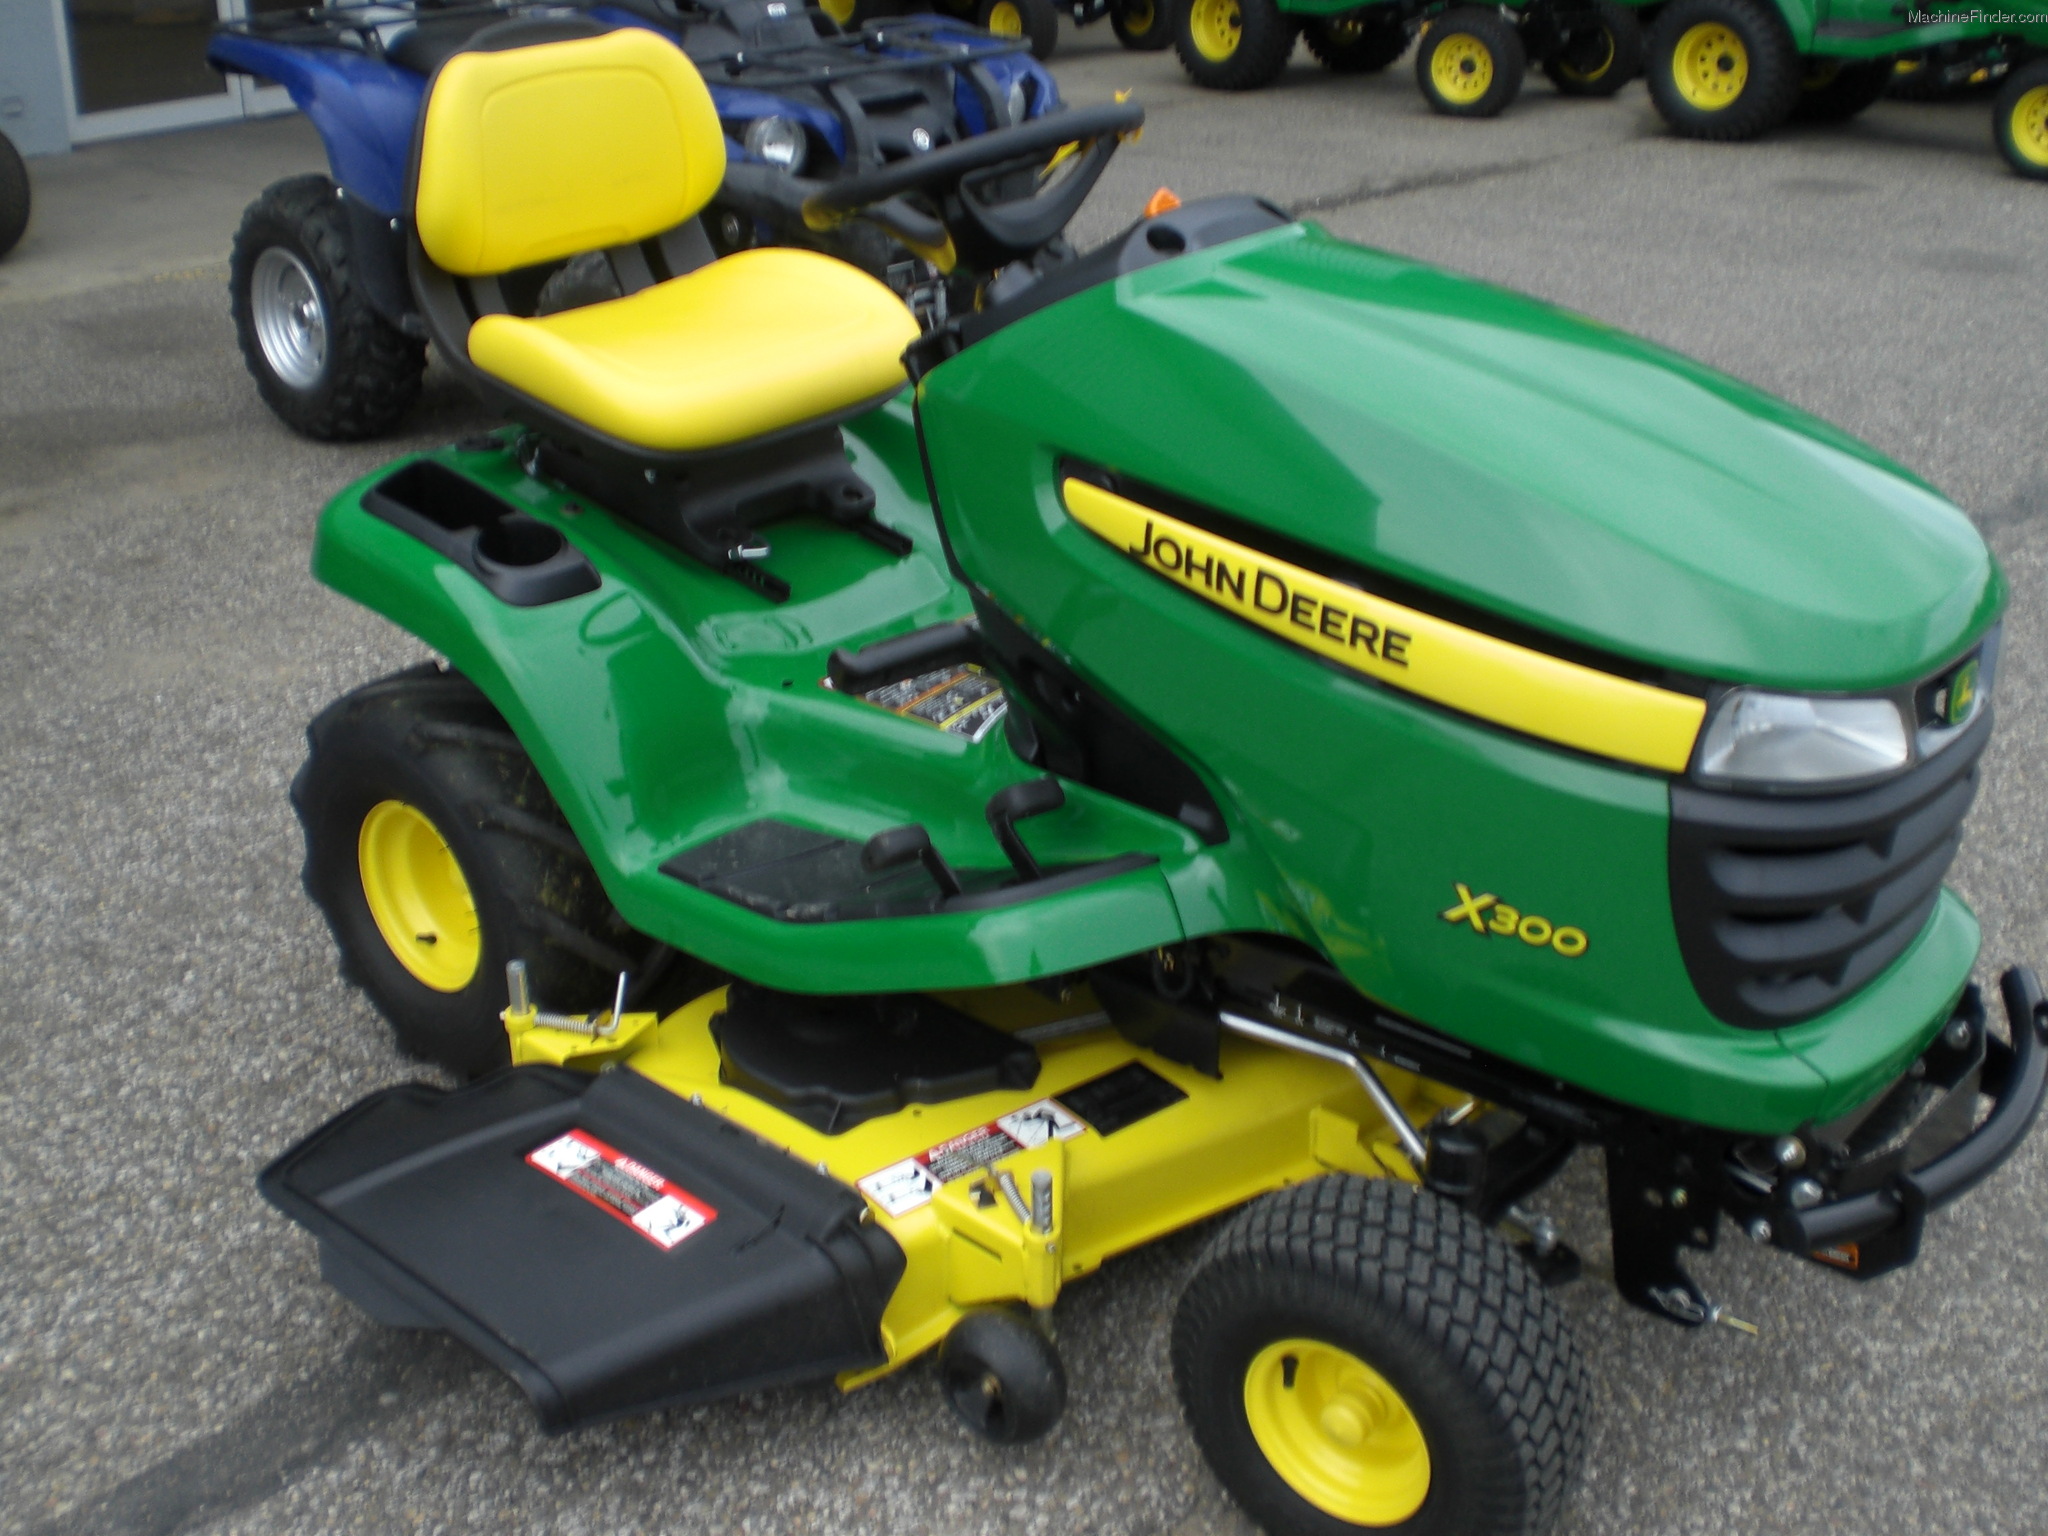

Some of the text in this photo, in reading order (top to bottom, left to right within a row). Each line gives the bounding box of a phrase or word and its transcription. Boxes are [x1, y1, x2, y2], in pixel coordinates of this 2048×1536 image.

[1128, 520, 1412, 668] JOHN DEERE
[1437, 881, 1589, 958] X300
